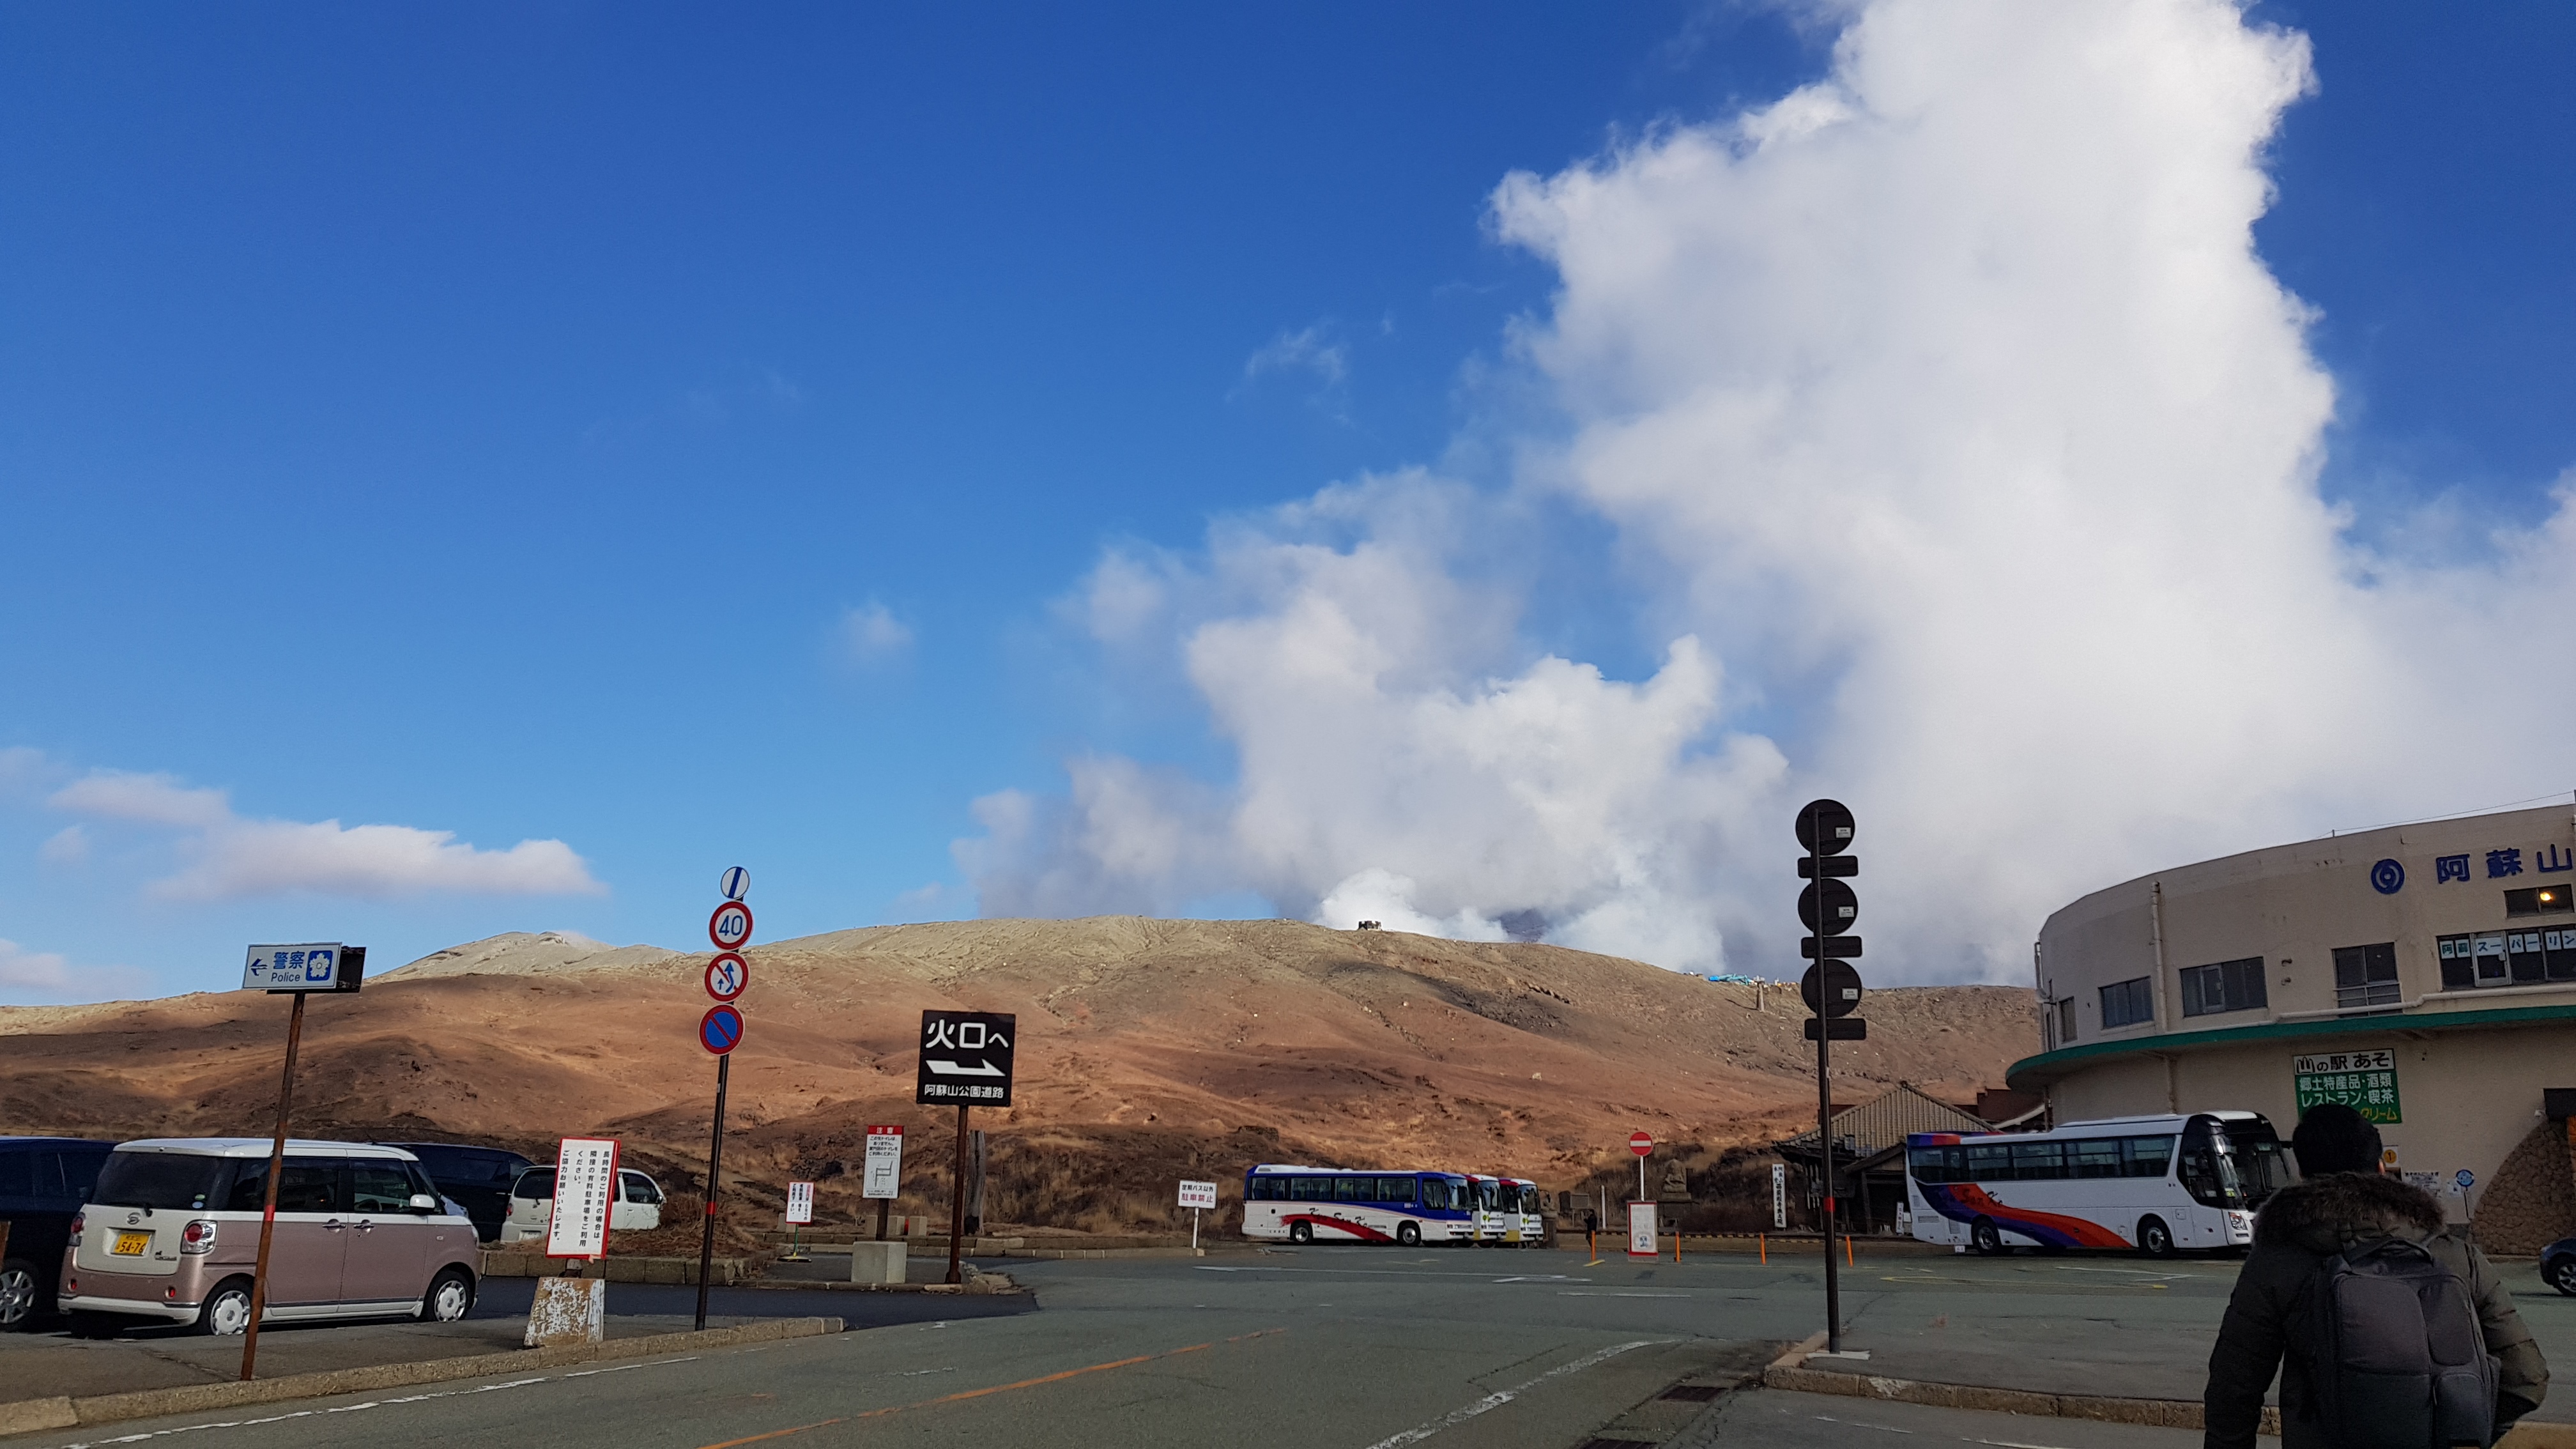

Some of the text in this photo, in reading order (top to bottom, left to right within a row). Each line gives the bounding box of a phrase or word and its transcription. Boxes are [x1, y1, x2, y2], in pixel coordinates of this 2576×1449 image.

[718, 915, 743, 936] 40
[273, 951, 305, 969] 警察
[271, 972, 300, 982] Police
[926, 1018, 1009, 1050] 火口へ
[2297, 1053, 2389, 1074] 山の駅 あそ
[924, 1084, 1004, 1098] 阿蘇山公園道路
[574, 1151, 583, 1184] ください。
[594, 1151, 610, 1245] 長時間のご利用の場合は、
